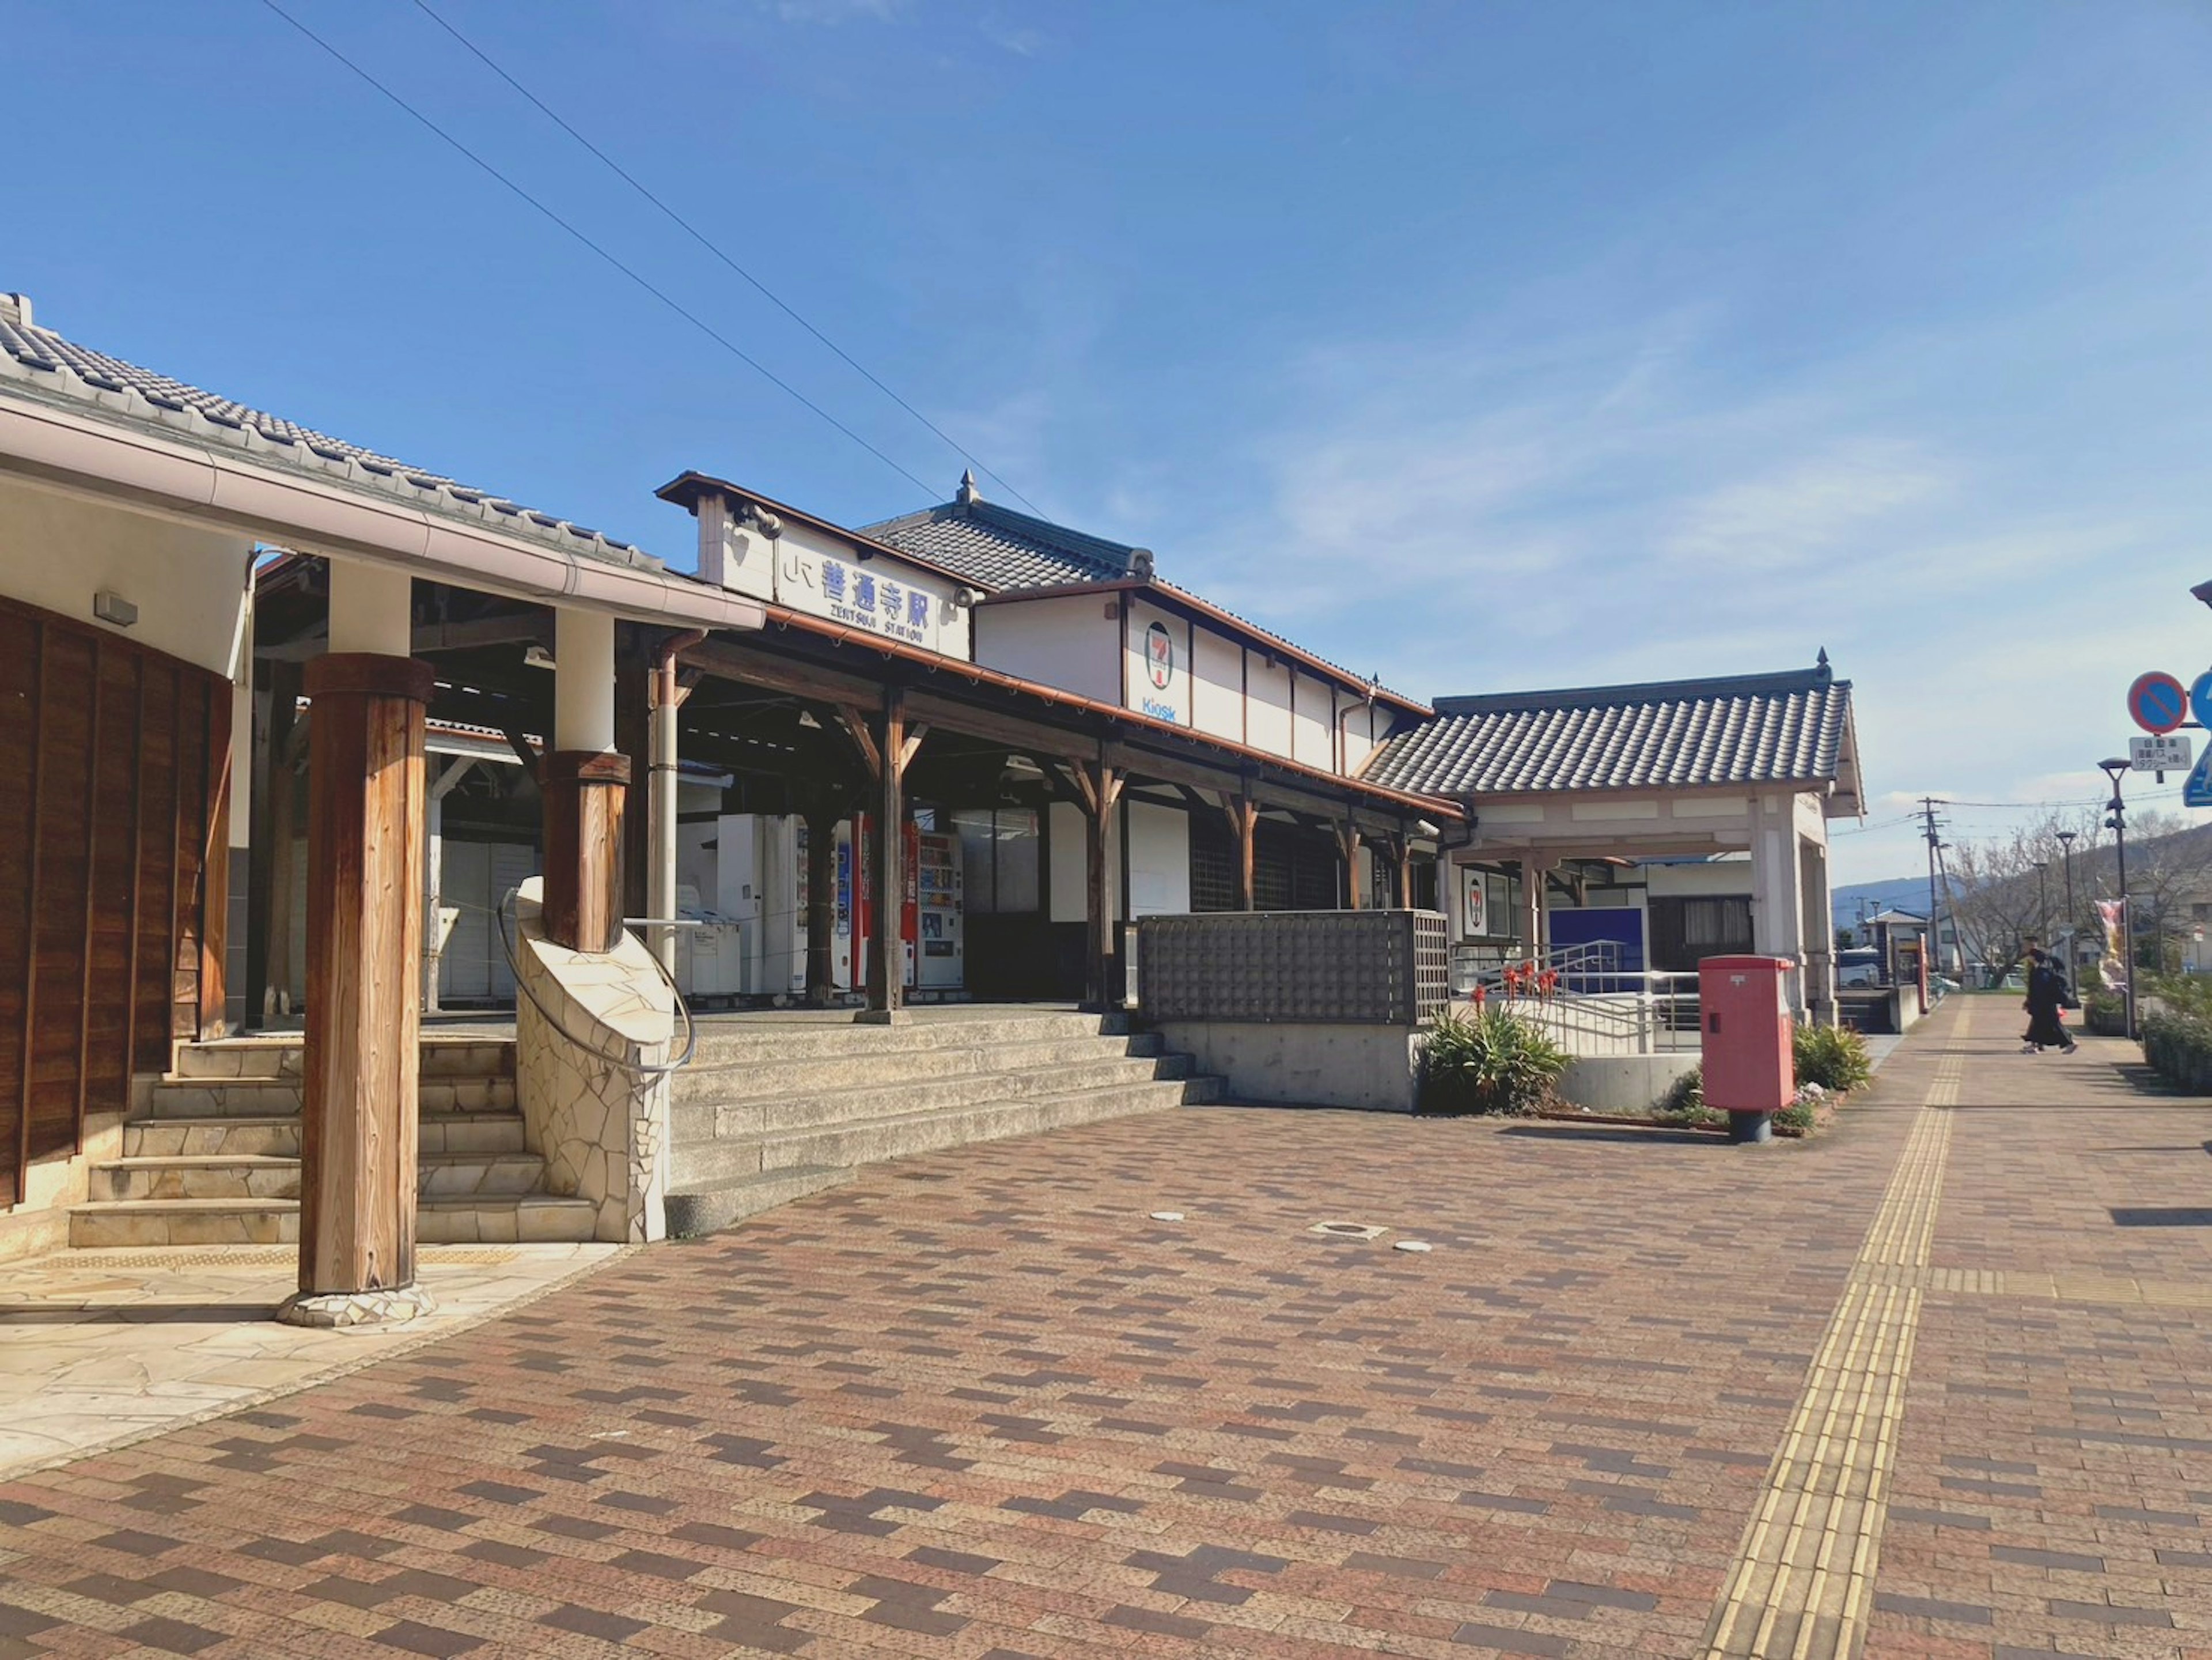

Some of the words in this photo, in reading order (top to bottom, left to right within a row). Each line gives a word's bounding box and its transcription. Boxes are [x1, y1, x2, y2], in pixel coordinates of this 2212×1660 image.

[822, 559, 929, 629] 善通寺駅
[830, 603, 877, 629] ZENTSUJI
[884, 621, 923, 643] STATION
[1142, 696, 1176, 722] Kiosk
